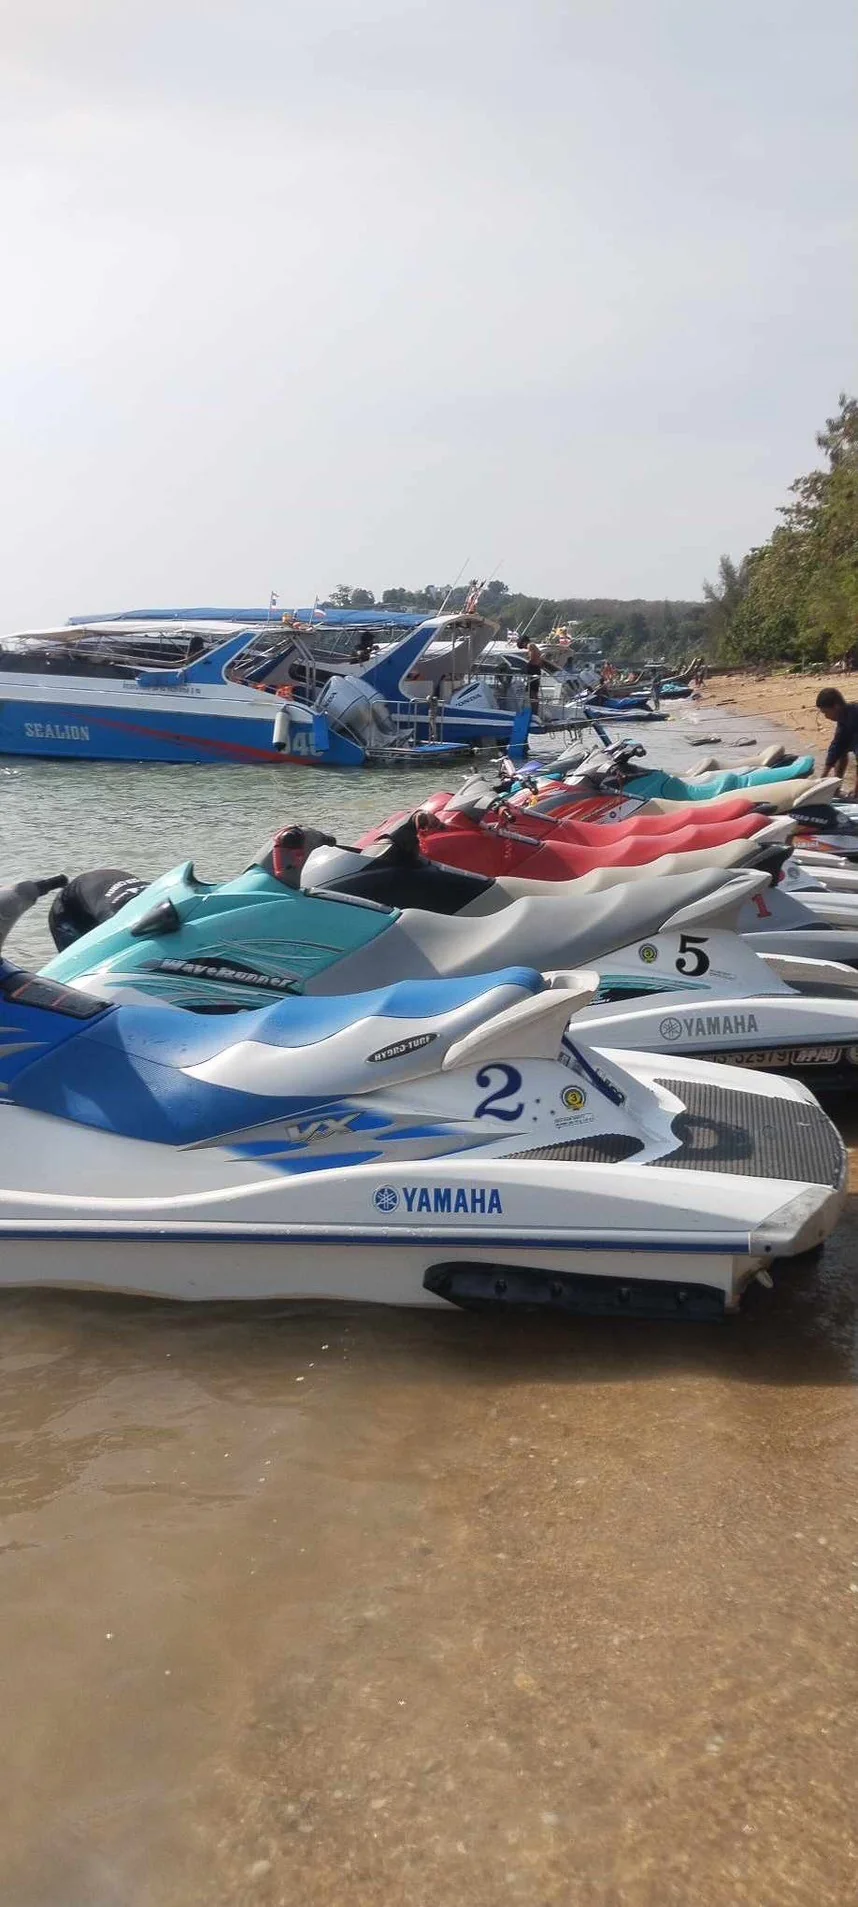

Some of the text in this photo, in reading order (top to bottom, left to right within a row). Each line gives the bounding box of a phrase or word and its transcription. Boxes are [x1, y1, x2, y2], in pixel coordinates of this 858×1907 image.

[24, 722, 90, 741] SEALION
[751, 893, 772, 918] 1
[675, 934, 710, 977] 5
[160, 958, 294, 988] WaveRunner
[683, 1013, 758, 1036] YAMAHA
[374, 1035, 431, 1061] HYDRO-TURF
[475, 1064, 524, 1121] 2
[285, 1111, 365, 1142] VX
[402, 1187, 503, 1214] YAMAHA
